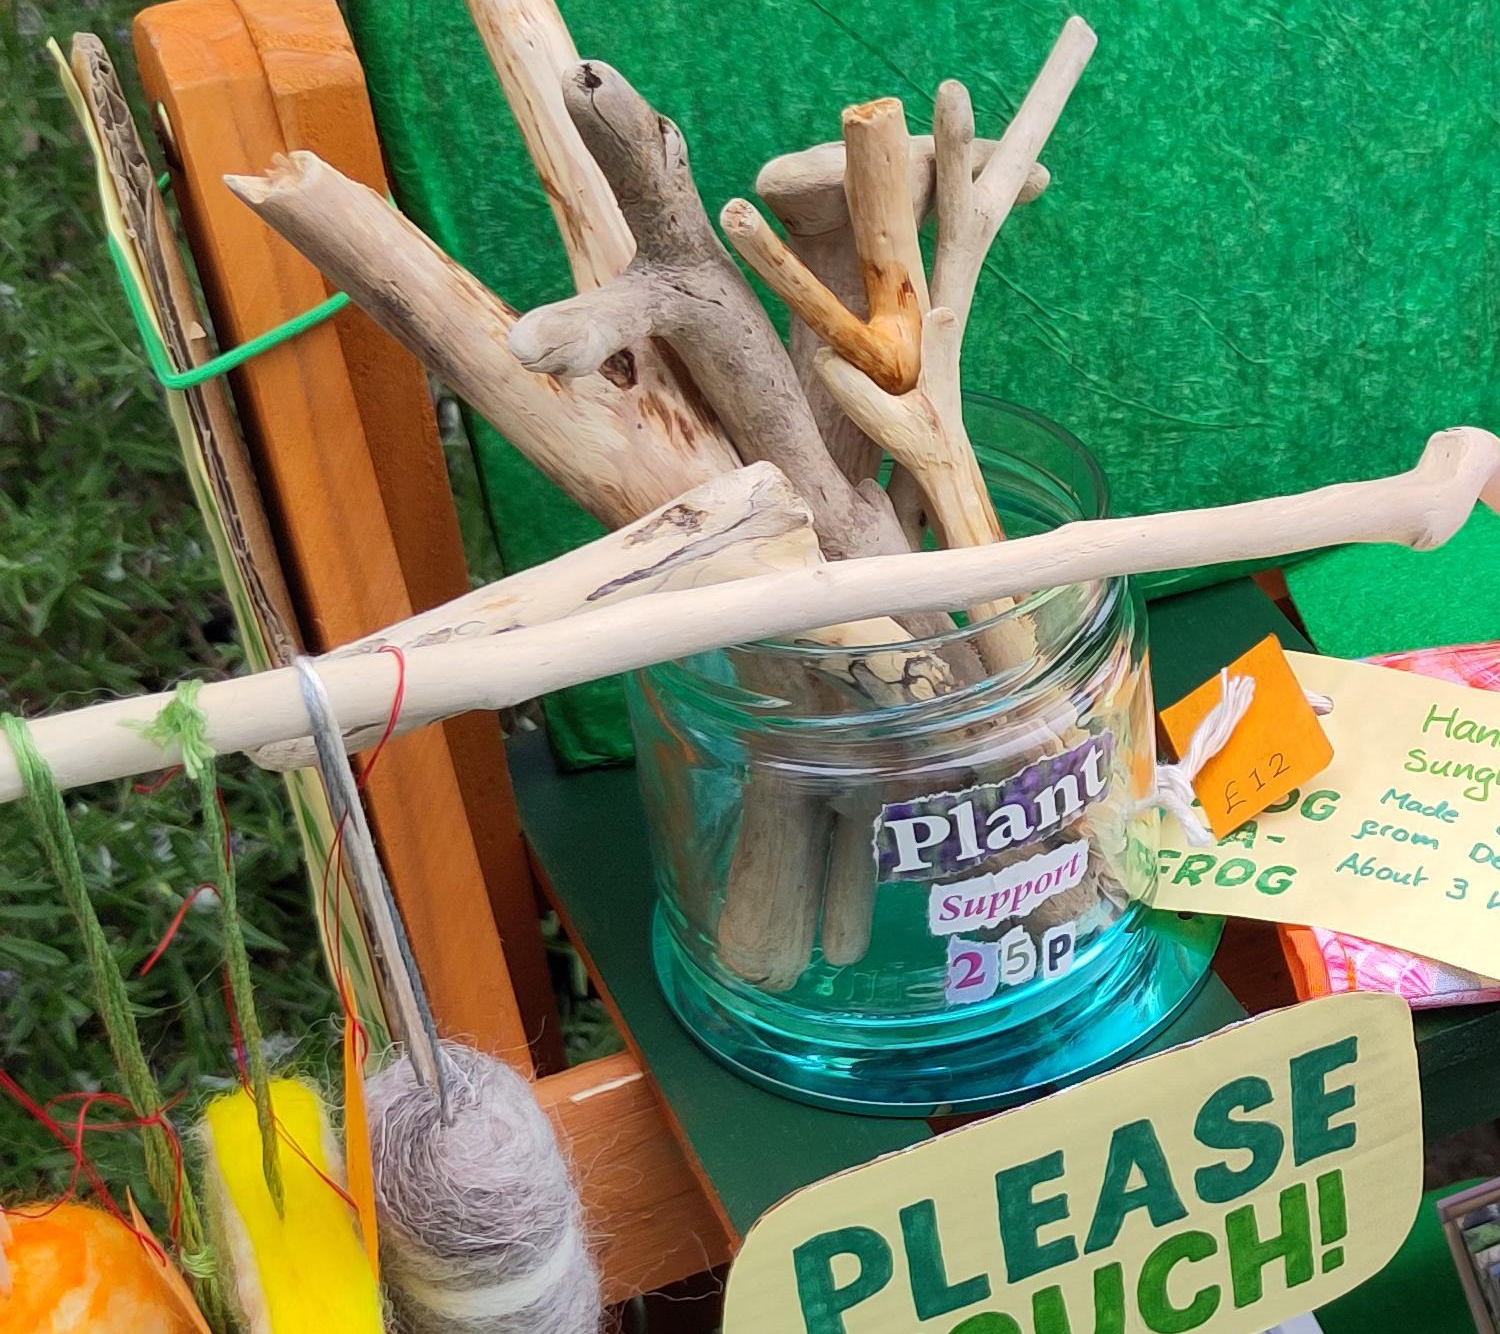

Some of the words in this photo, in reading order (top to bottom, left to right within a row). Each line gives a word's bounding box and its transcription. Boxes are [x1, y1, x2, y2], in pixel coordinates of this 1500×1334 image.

[884, 745, 1107, 873] Plant
[1380, 788, 1459, 823] Made
[1351, 820, 1439, 850] from
[938, 852, 1082, 921] Support
[1336, 852, 1430, 887] About
[1446, 878, 1469, 900] 3
